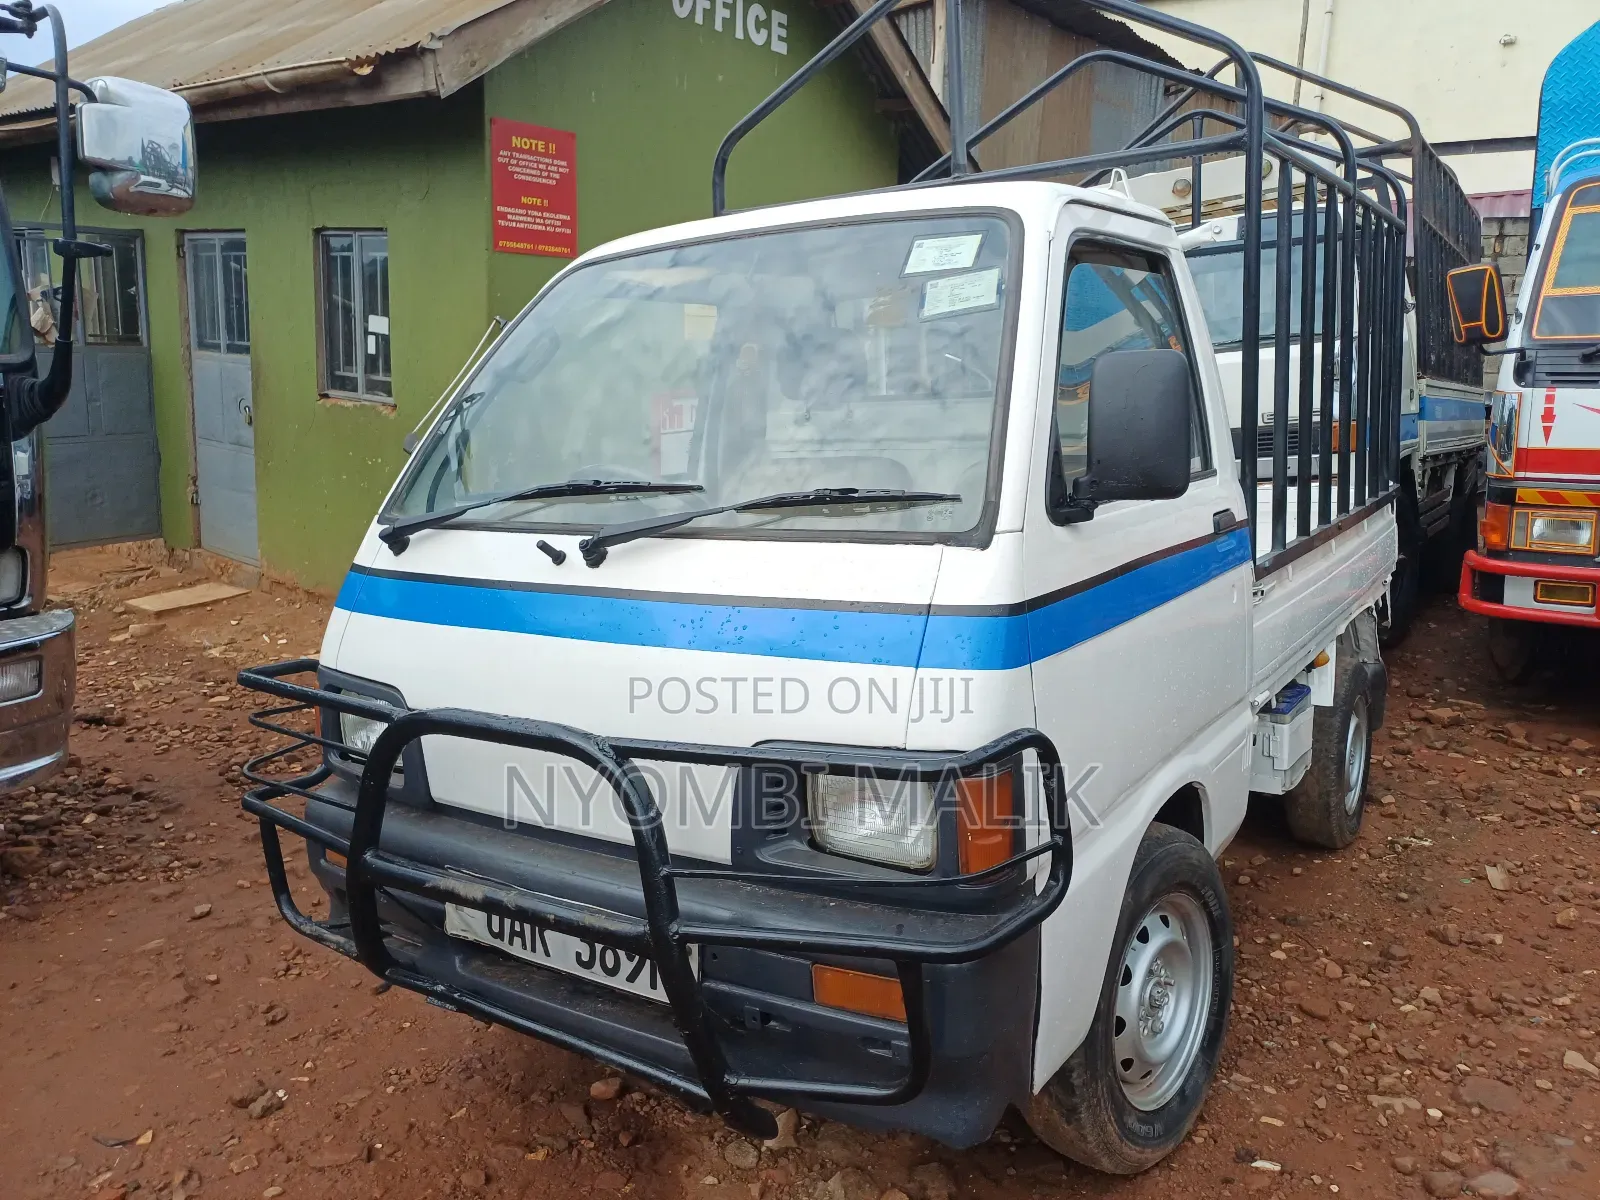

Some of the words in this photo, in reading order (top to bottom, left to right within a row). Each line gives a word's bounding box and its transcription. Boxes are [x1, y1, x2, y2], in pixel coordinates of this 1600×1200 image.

[511, 136, 546, 152] NOTE
[548, 143, 556, 154] !!
[512, 152, 553, 165] TRANSACTIONS
[519, 160, 538, 169] OFFICE
[508, 165, 541, 176] CONCERNED
[549, 171, 560, 179] THE
[513, 173, 557, 185] CONSEQUENCES
[521, 196, 542, 206] NOTE
